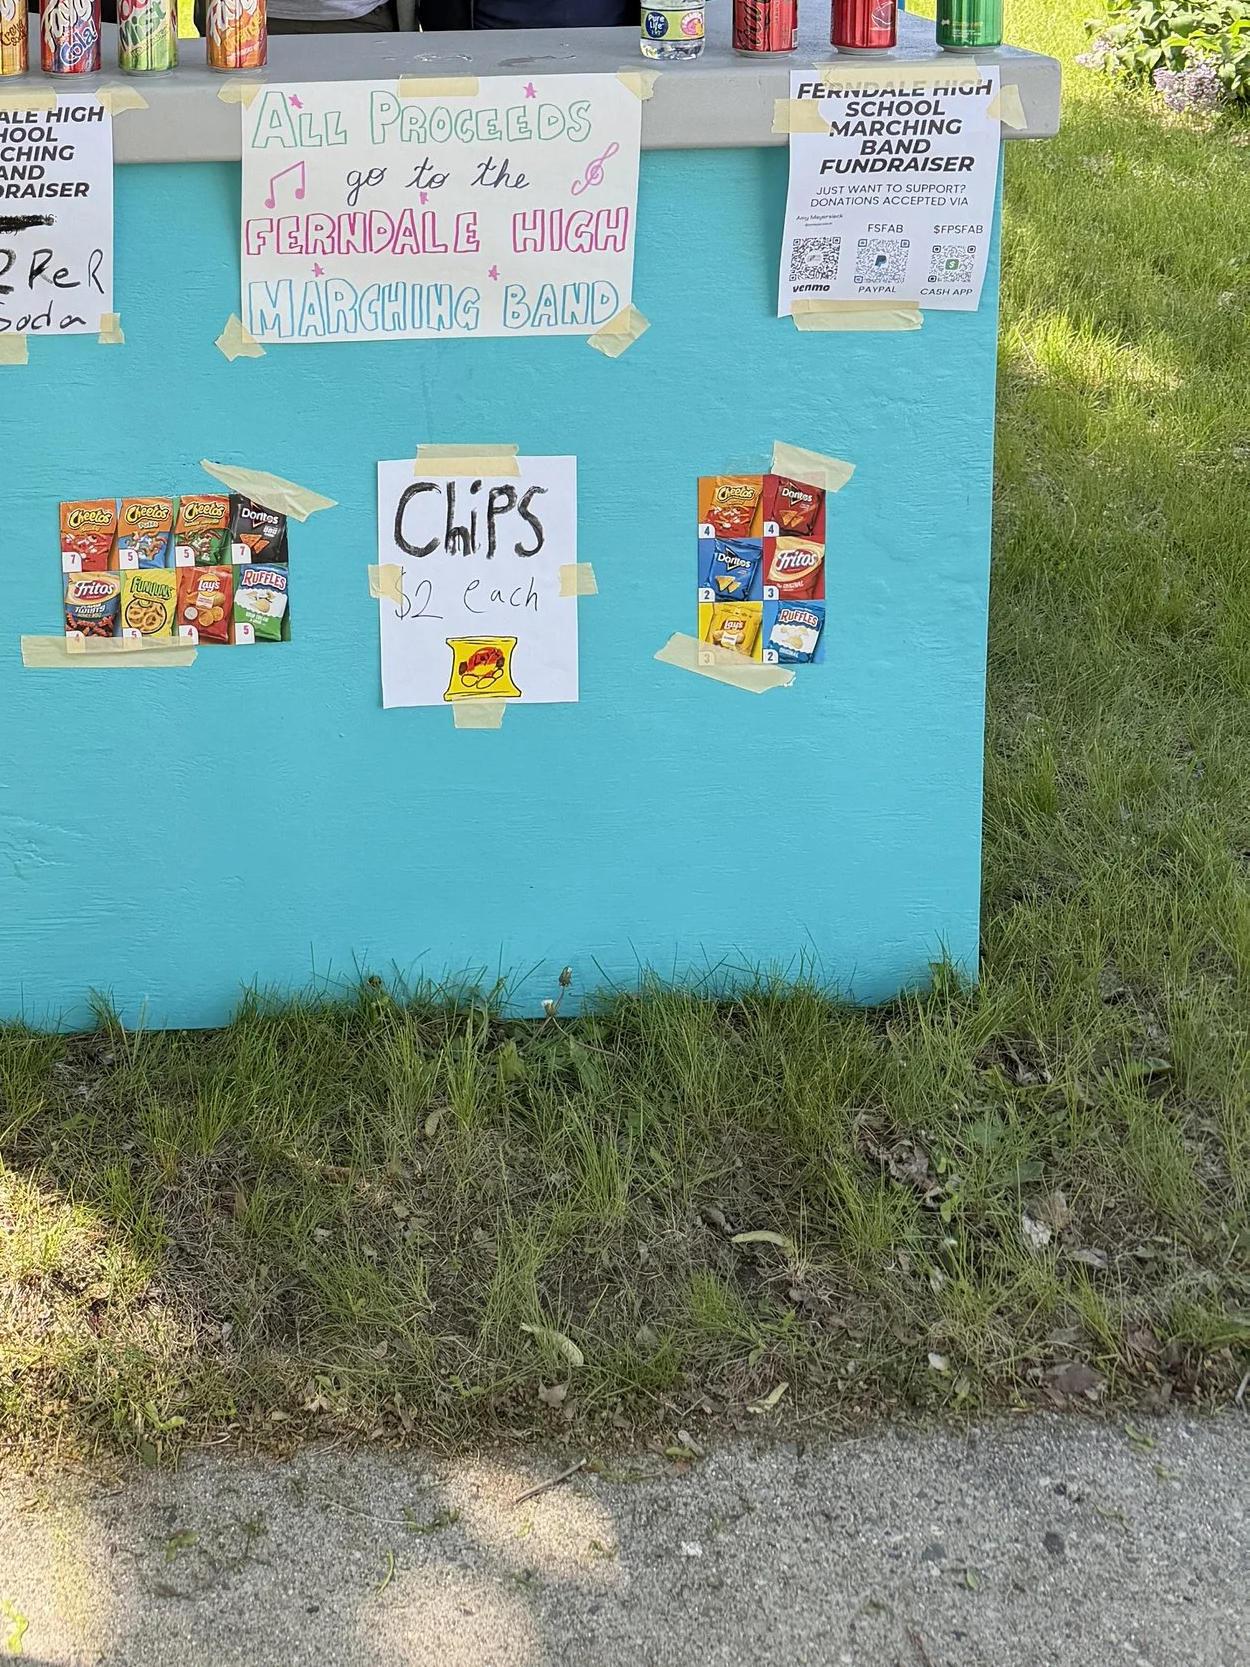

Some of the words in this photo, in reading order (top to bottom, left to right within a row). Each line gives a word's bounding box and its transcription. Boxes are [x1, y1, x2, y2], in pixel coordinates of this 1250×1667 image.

[798, 80, 925, 99] FERNDALE
[933, 79, 993, 96] HIGH
[45, 106, 105, 123] HIGH
[845, 100, 945, 117] SCHOOL
[829, 118, 963, 137] MARCHING
[860, 138, 931, 155] BAND
[819, 156, 975, 175] FUNDRAISER
[347, 166, 387, 206] go
[405, 157, 449, 189] to
[471, 156, 530, 189] the
[816, 186, 845, 195] JUST
[848, 184, 884, 194] WANT
[886, 184, 902, 193] TO
[905, 183, 967, 194] SUPPORT?
[810, 196, 879, 207] DONATIONS
[882, 196, 946, 206] ACCEPTED
[949, 196, 969, 206] VIA
[245, 208, 480, 255] FERNDALE
[513, 206, 629, 253] HIGH
[868, 223, 904, 233] FSFAB
[933, 224, 984, 235] $FPSFAB
[792, 284, 831, 293] venmo
[858, 285, 897, 293] PAYPAL
[920, 288, 950, 296] CASH
[952, 288, 973, 296] APP
[249, 279, 480, 337] MARCHING
[503, 280, 619, 329] BAND
[716, 485, 755, 503] Cheetos
[782, 488, 812, 502] Doritos
[69, 509, 112, 528] Cheetos
[126, 504, 170, 524] Cheetos
[185, 501, 226, 522] Cheetos
[241, 508, 279, 524] Doritos
[704, 525, 710, 535] 4
[768, 524, 774, 534] 4
[128, 552, 133, 561] 5
[184, 549, 190, 559] 5
[240, 546, 246, 556] 7
[71, 554, 76, 564] 7
[717, 553, 751, 568] Doritos
[777, 550, 818, 570] Fritos
[198, 580, 220, 592] Lay's
[242, 570, 286, 590] RUFFLES
[75, 581, 114, 598] Fritos
[395, 566, 443, 620] $2
[464, 577, 539, 613] each
[704, 591, 710, 600] 2
[768, 588, 774, 598] 3
[779, 609, 818, 627] RUFFLES
[187, 628, 193, 637] 4
[243, 625, 249, 635] 5
[767, 652, 774, 661] 2
